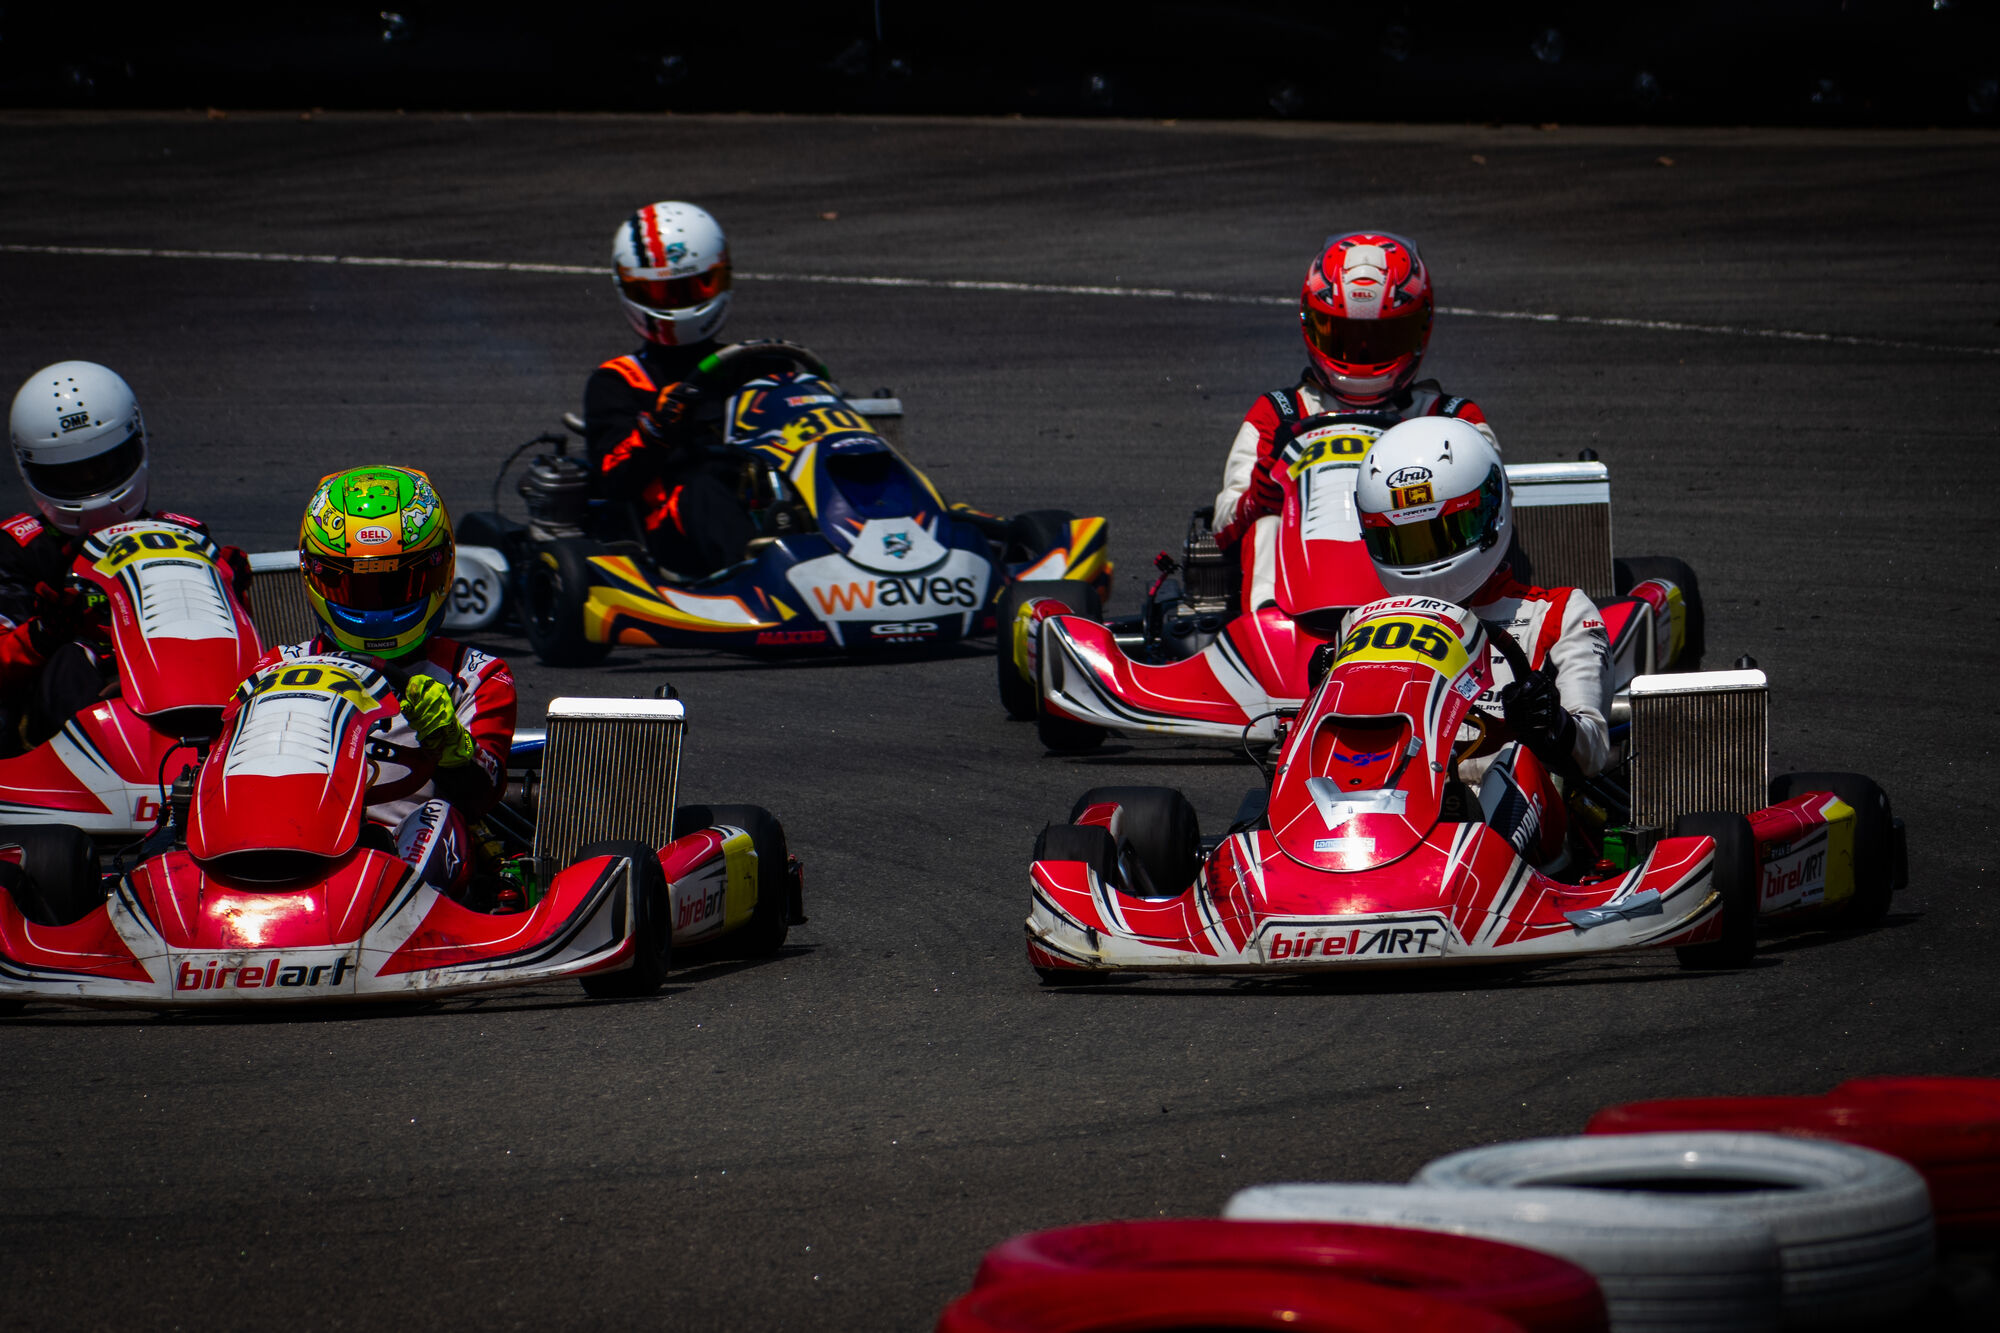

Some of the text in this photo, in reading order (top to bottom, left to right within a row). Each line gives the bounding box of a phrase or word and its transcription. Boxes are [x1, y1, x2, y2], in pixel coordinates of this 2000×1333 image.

[60, 414, 89, 430] OMP
[1395, 468, 1427, 482] Arai
[14, 519, 41, 538] OMP
[360, 530, 387, 539] BELL
[1361, 598, 1455, 615] birelART
[870, 621, 939, 634] GP
[1336, 622, 1453, 662] 305
[402, 801, 443, 864] birelART
[1765, 850, 1826, 898] birelART
[677, 887, 726, 931] birelart
[1269, 928, 1439, 960] birelART
[175, 957, 355, 991] birelart
